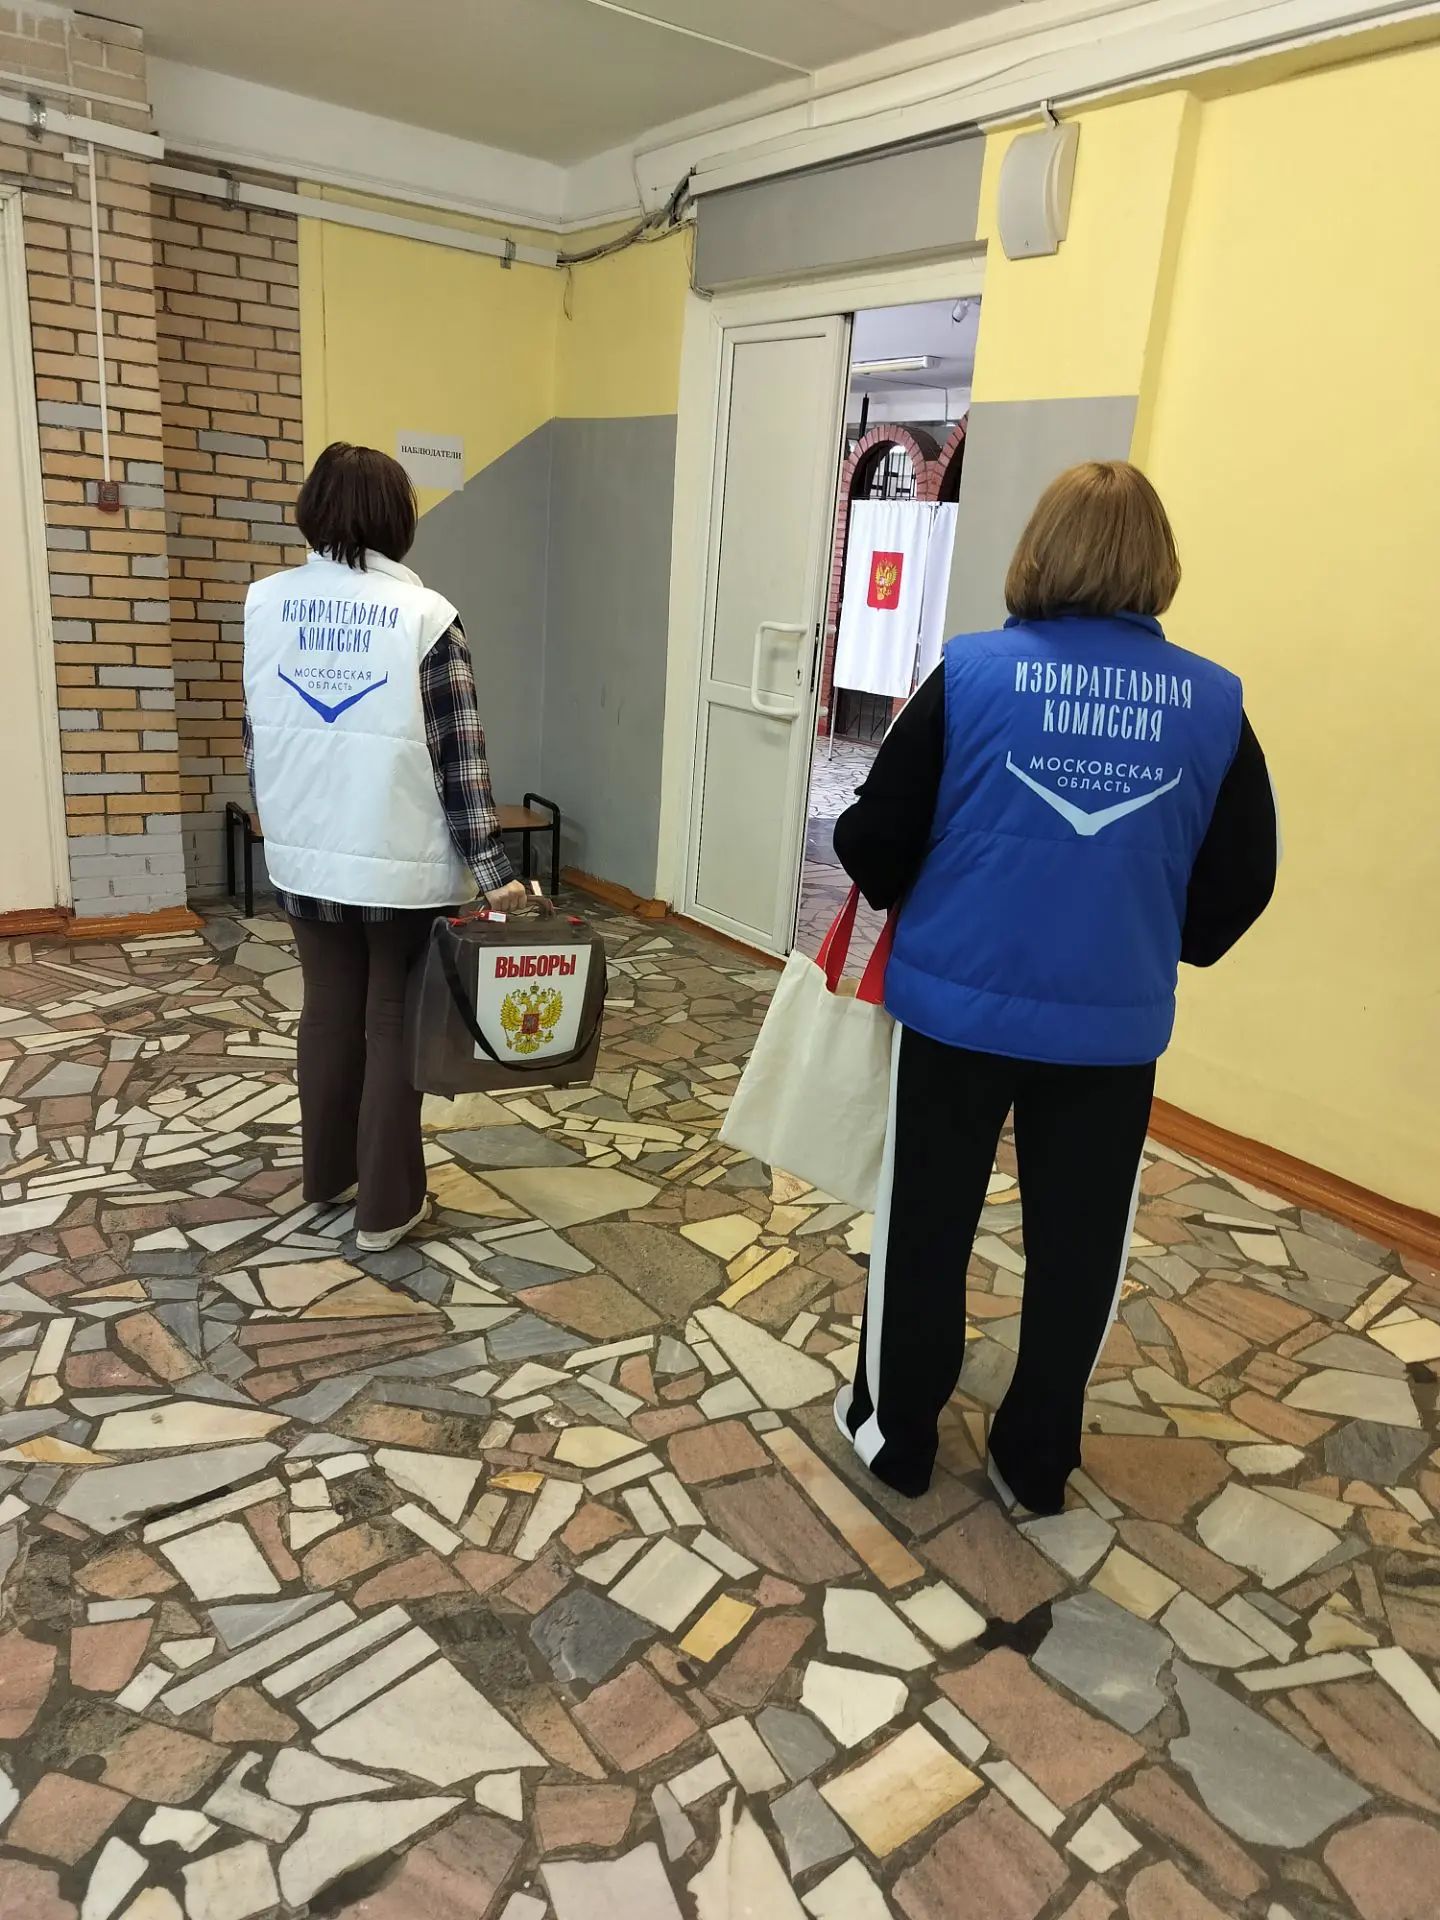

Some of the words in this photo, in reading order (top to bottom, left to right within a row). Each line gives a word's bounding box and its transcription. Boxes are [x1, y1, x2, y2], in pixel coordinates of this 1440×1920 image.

[401, 445, 462, 460] НАБЛЮДАТЕЛИ
[281, 599, 399, 629] ИЗБИРАТЕЛЬНАЯ
[299, 626, 371, 653] КОМИССИЯ
[294, 668, 372, 681] МОСКОВСКАЯ
[307, 681, 353, 691] ОБЛАСТЬ
[1015, 661, 1192, 709] ИЗБИРАТЕЛЬНАЯ
[1042, 699, 1163, 743] КОМИССИЯ
[1029, 755, 1164, 782] МОСКОВСКАЯ
[1057, 777, 1132, 794] ОБЛАСТЬ
[495, 954, 577, 979] ВЫБОРЫ
